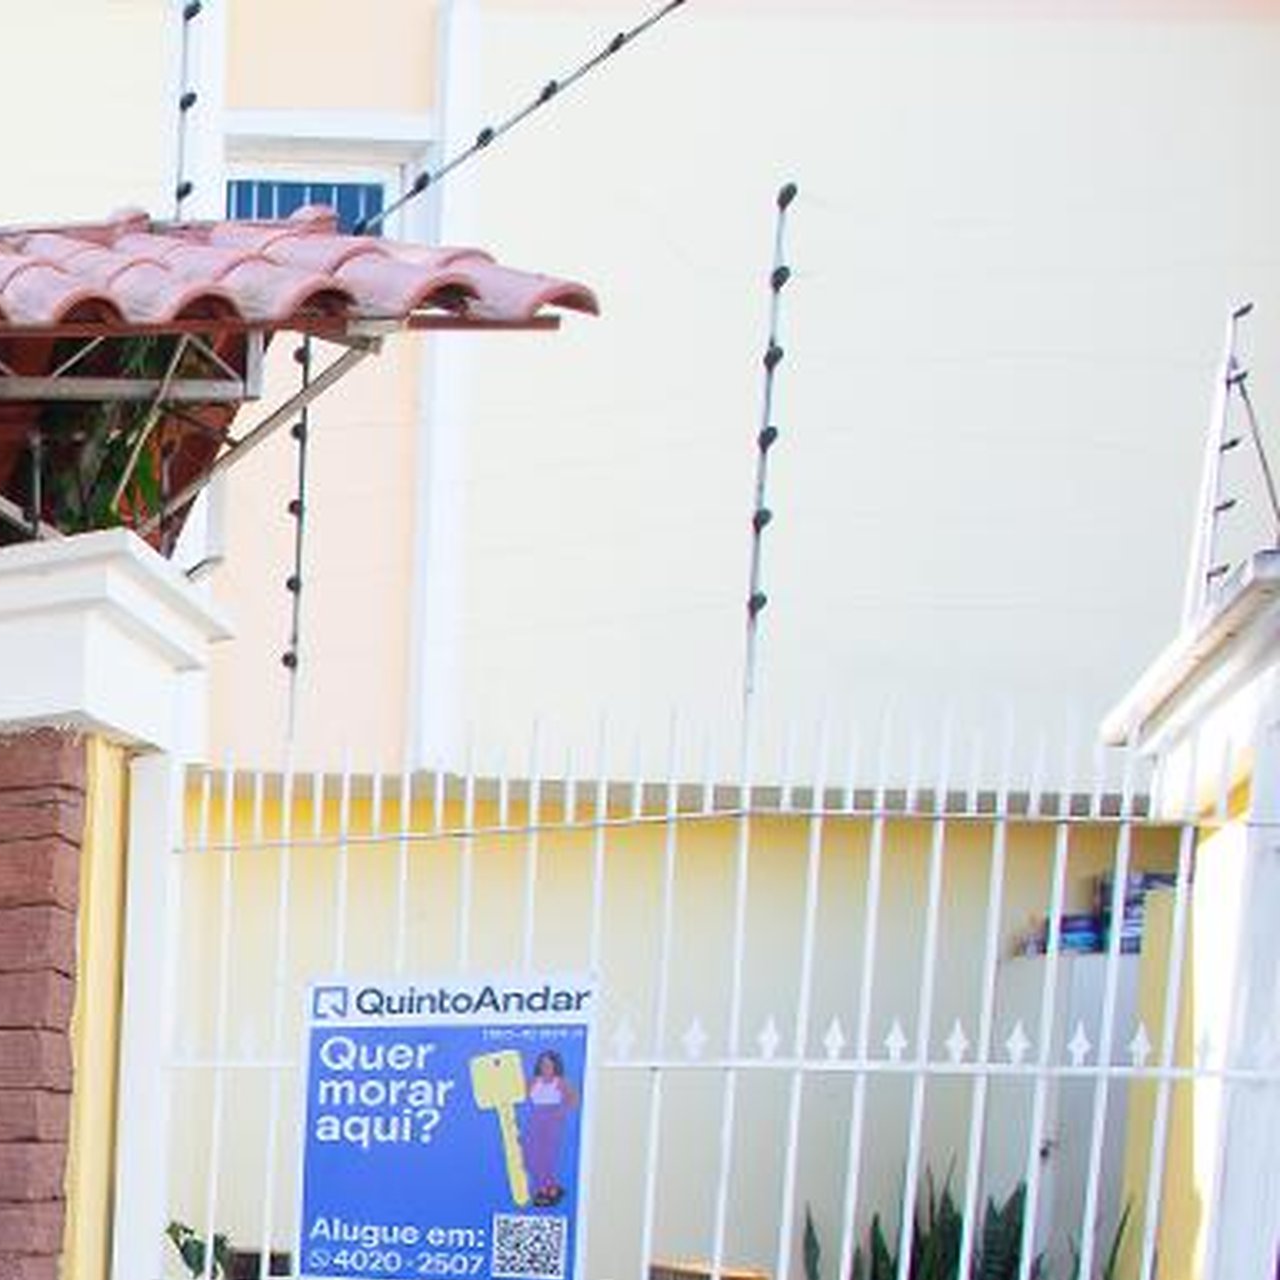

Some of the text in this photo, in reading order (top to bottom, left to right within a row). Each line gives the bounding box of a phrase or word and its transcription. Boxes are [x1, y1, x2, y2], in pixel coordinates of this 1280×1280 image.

[355, 986, 590, 1016] QuintoAndar
[320, 1035, 436, 1072] Quer
[319, 1078, 454, 1107] morar
[316, 1109, 440, 1148] aqui?
[309, 1218, 485, 1248] Alugue em:
